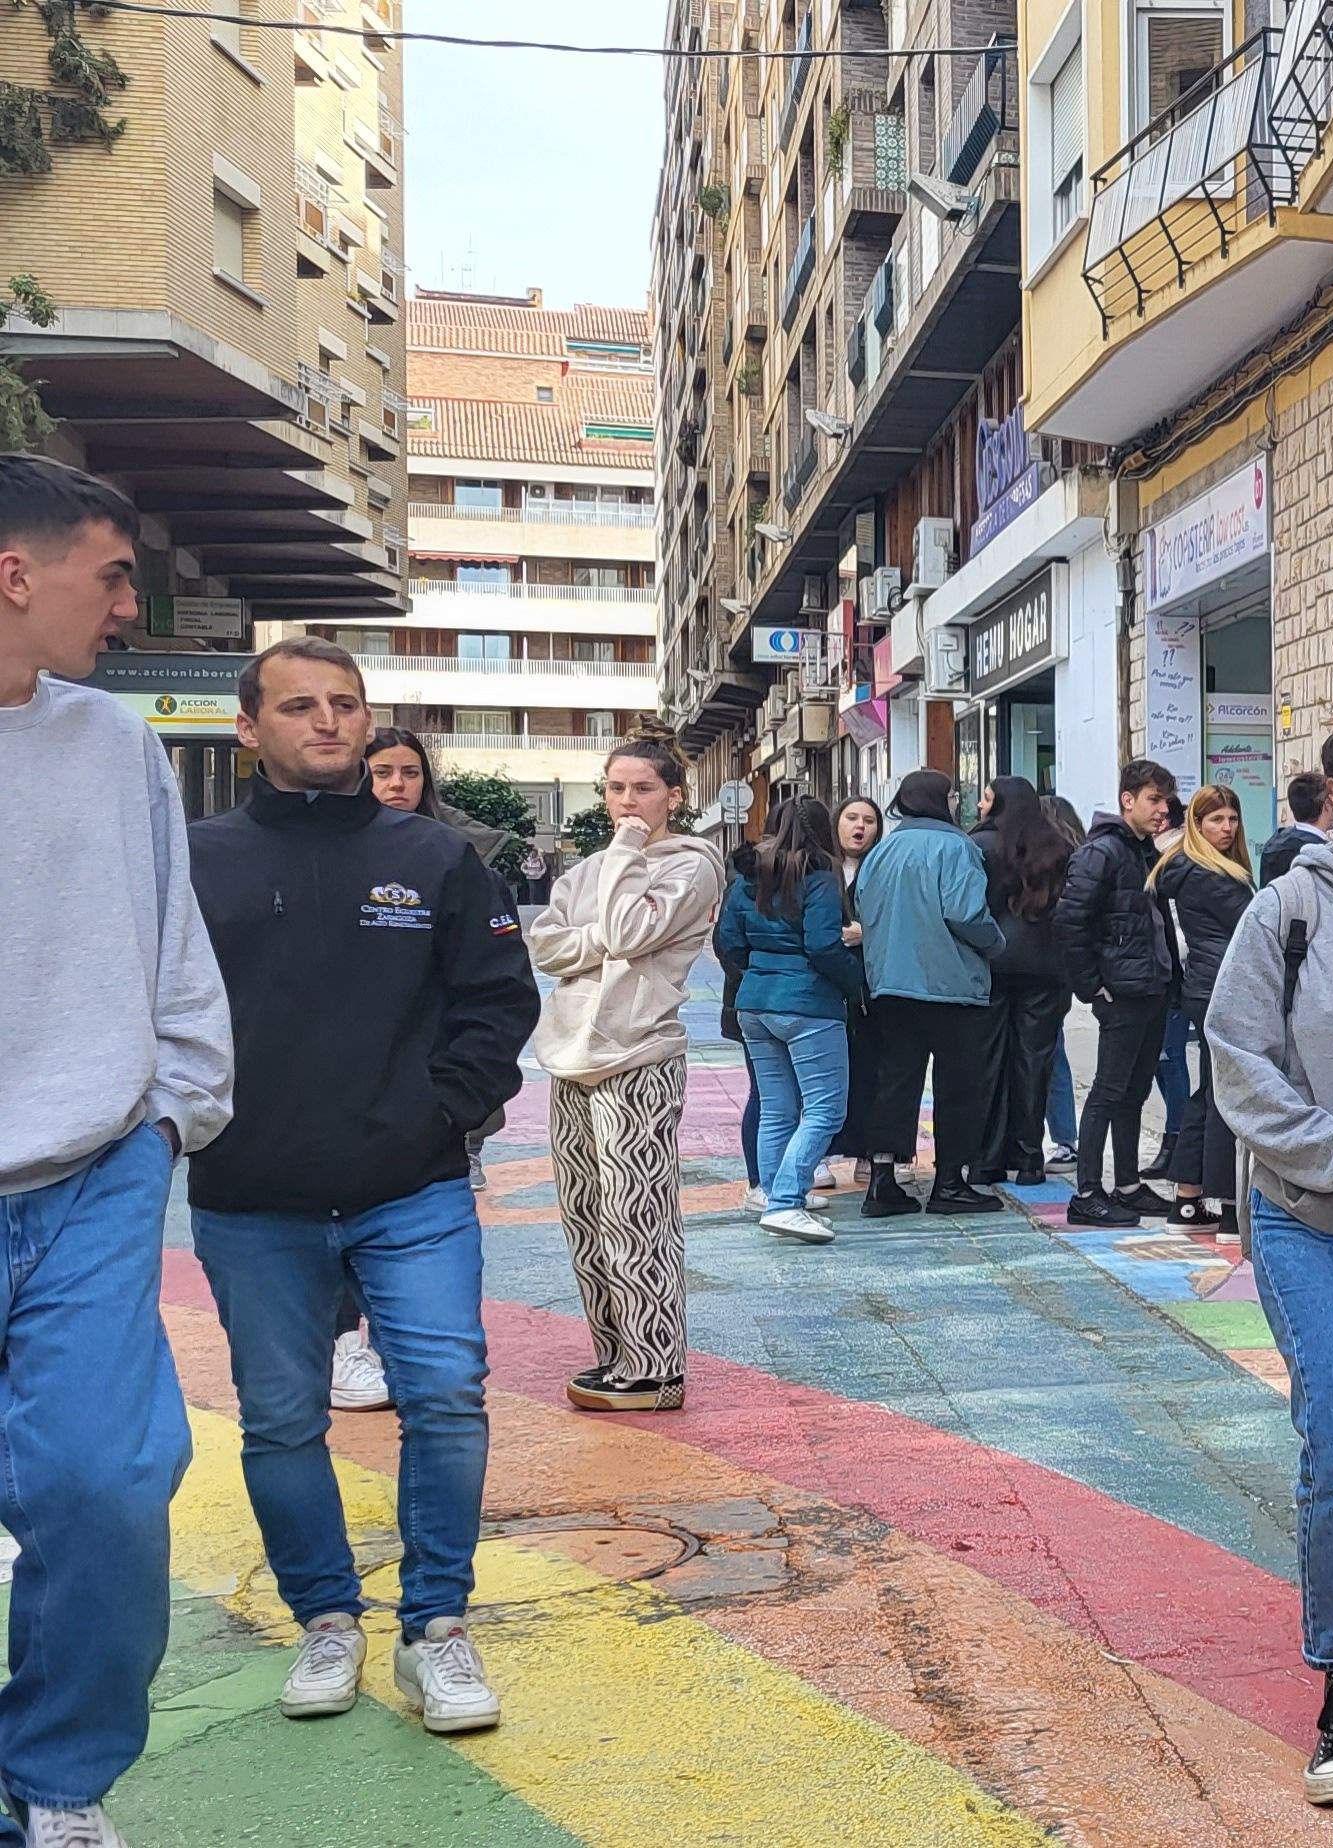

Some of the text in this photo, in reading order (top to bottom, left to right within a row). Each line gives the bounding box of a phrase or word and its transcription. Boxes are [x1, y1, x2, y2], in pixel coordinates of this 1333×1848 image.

[1009, 592, 1047, 661] HOGAR
[106, 668, 238, 678] www.accionlaboral
[1218, 704, 1267, 716] Alcorcón
